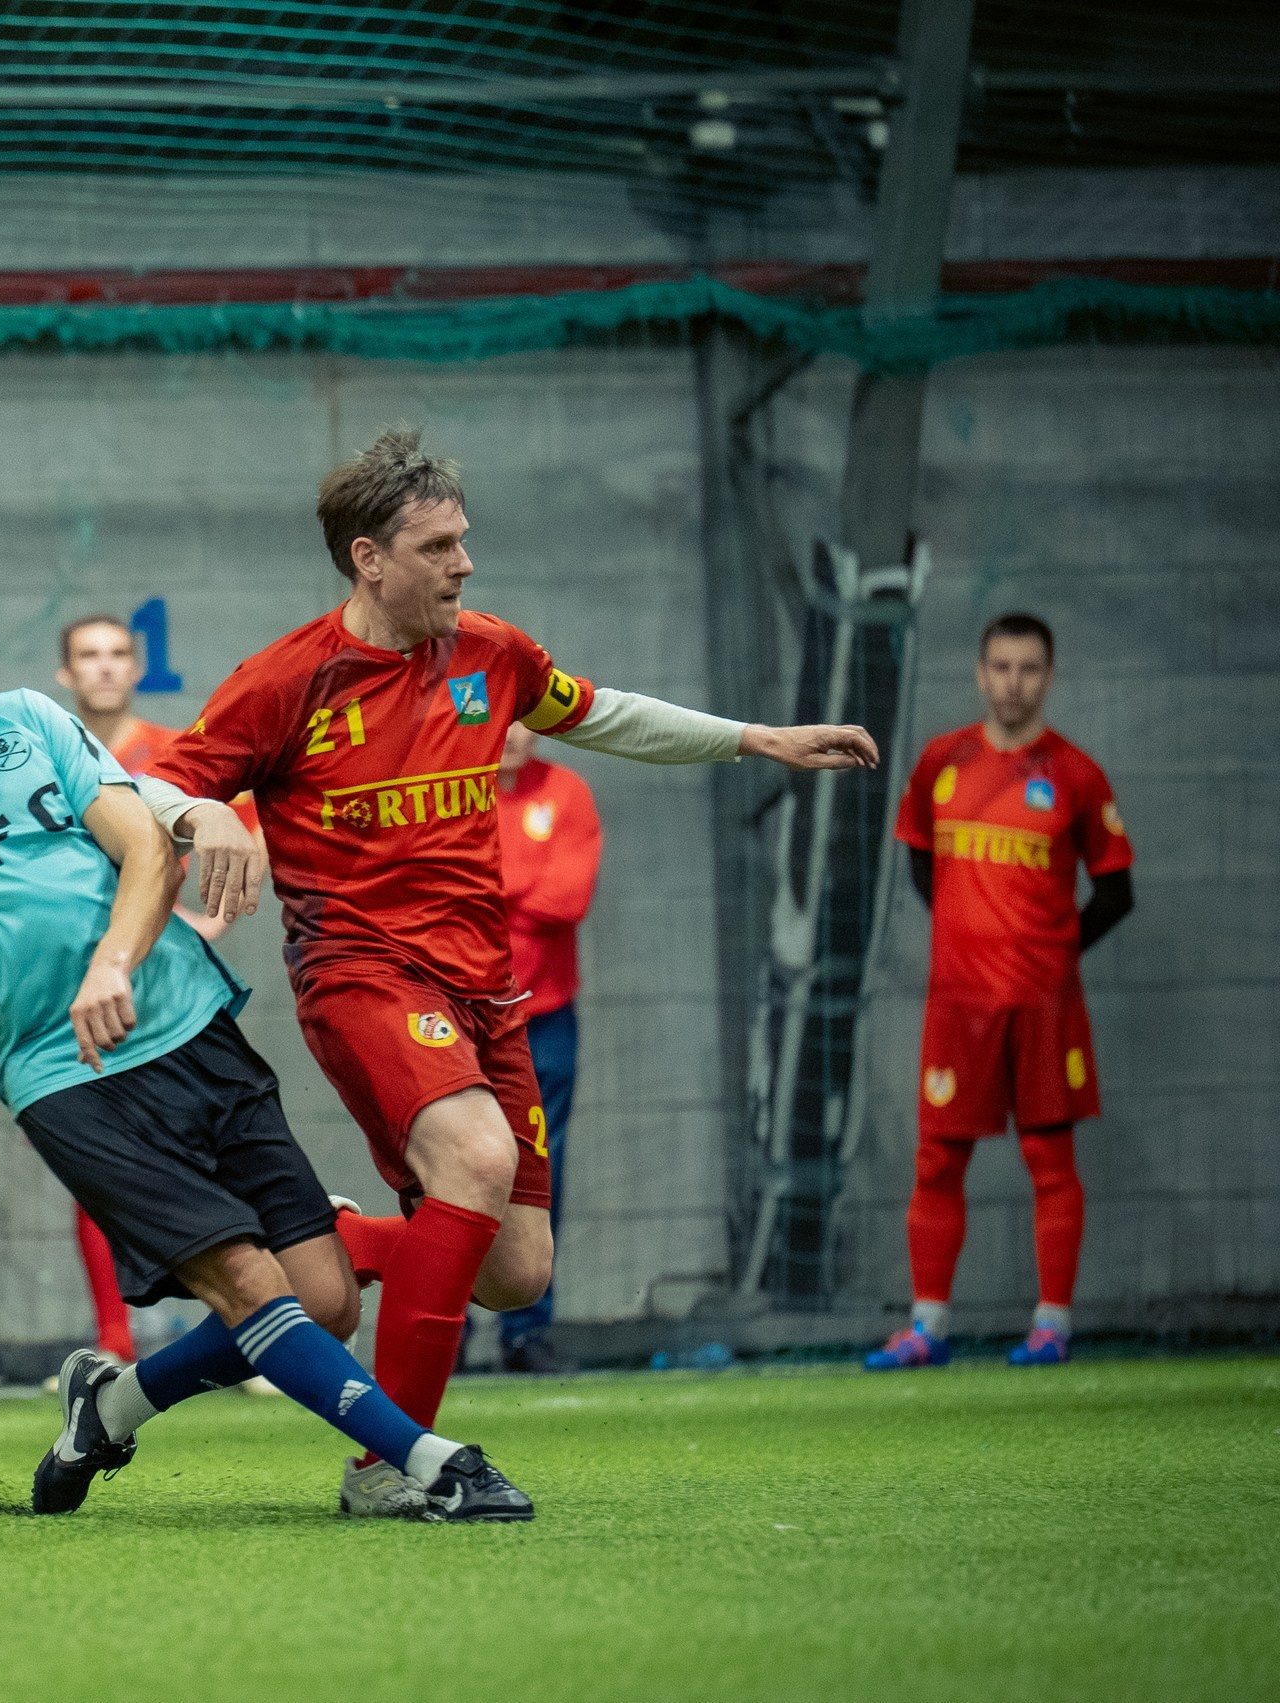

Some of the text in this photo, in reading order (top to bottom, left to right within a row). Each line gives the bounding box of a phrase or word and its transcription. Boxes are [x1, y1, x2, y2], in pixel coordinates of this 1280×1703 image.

[131, 597, 183, 692] 1
[550, 674, 575, 707] C
[306, 698, 365, 756] 21
